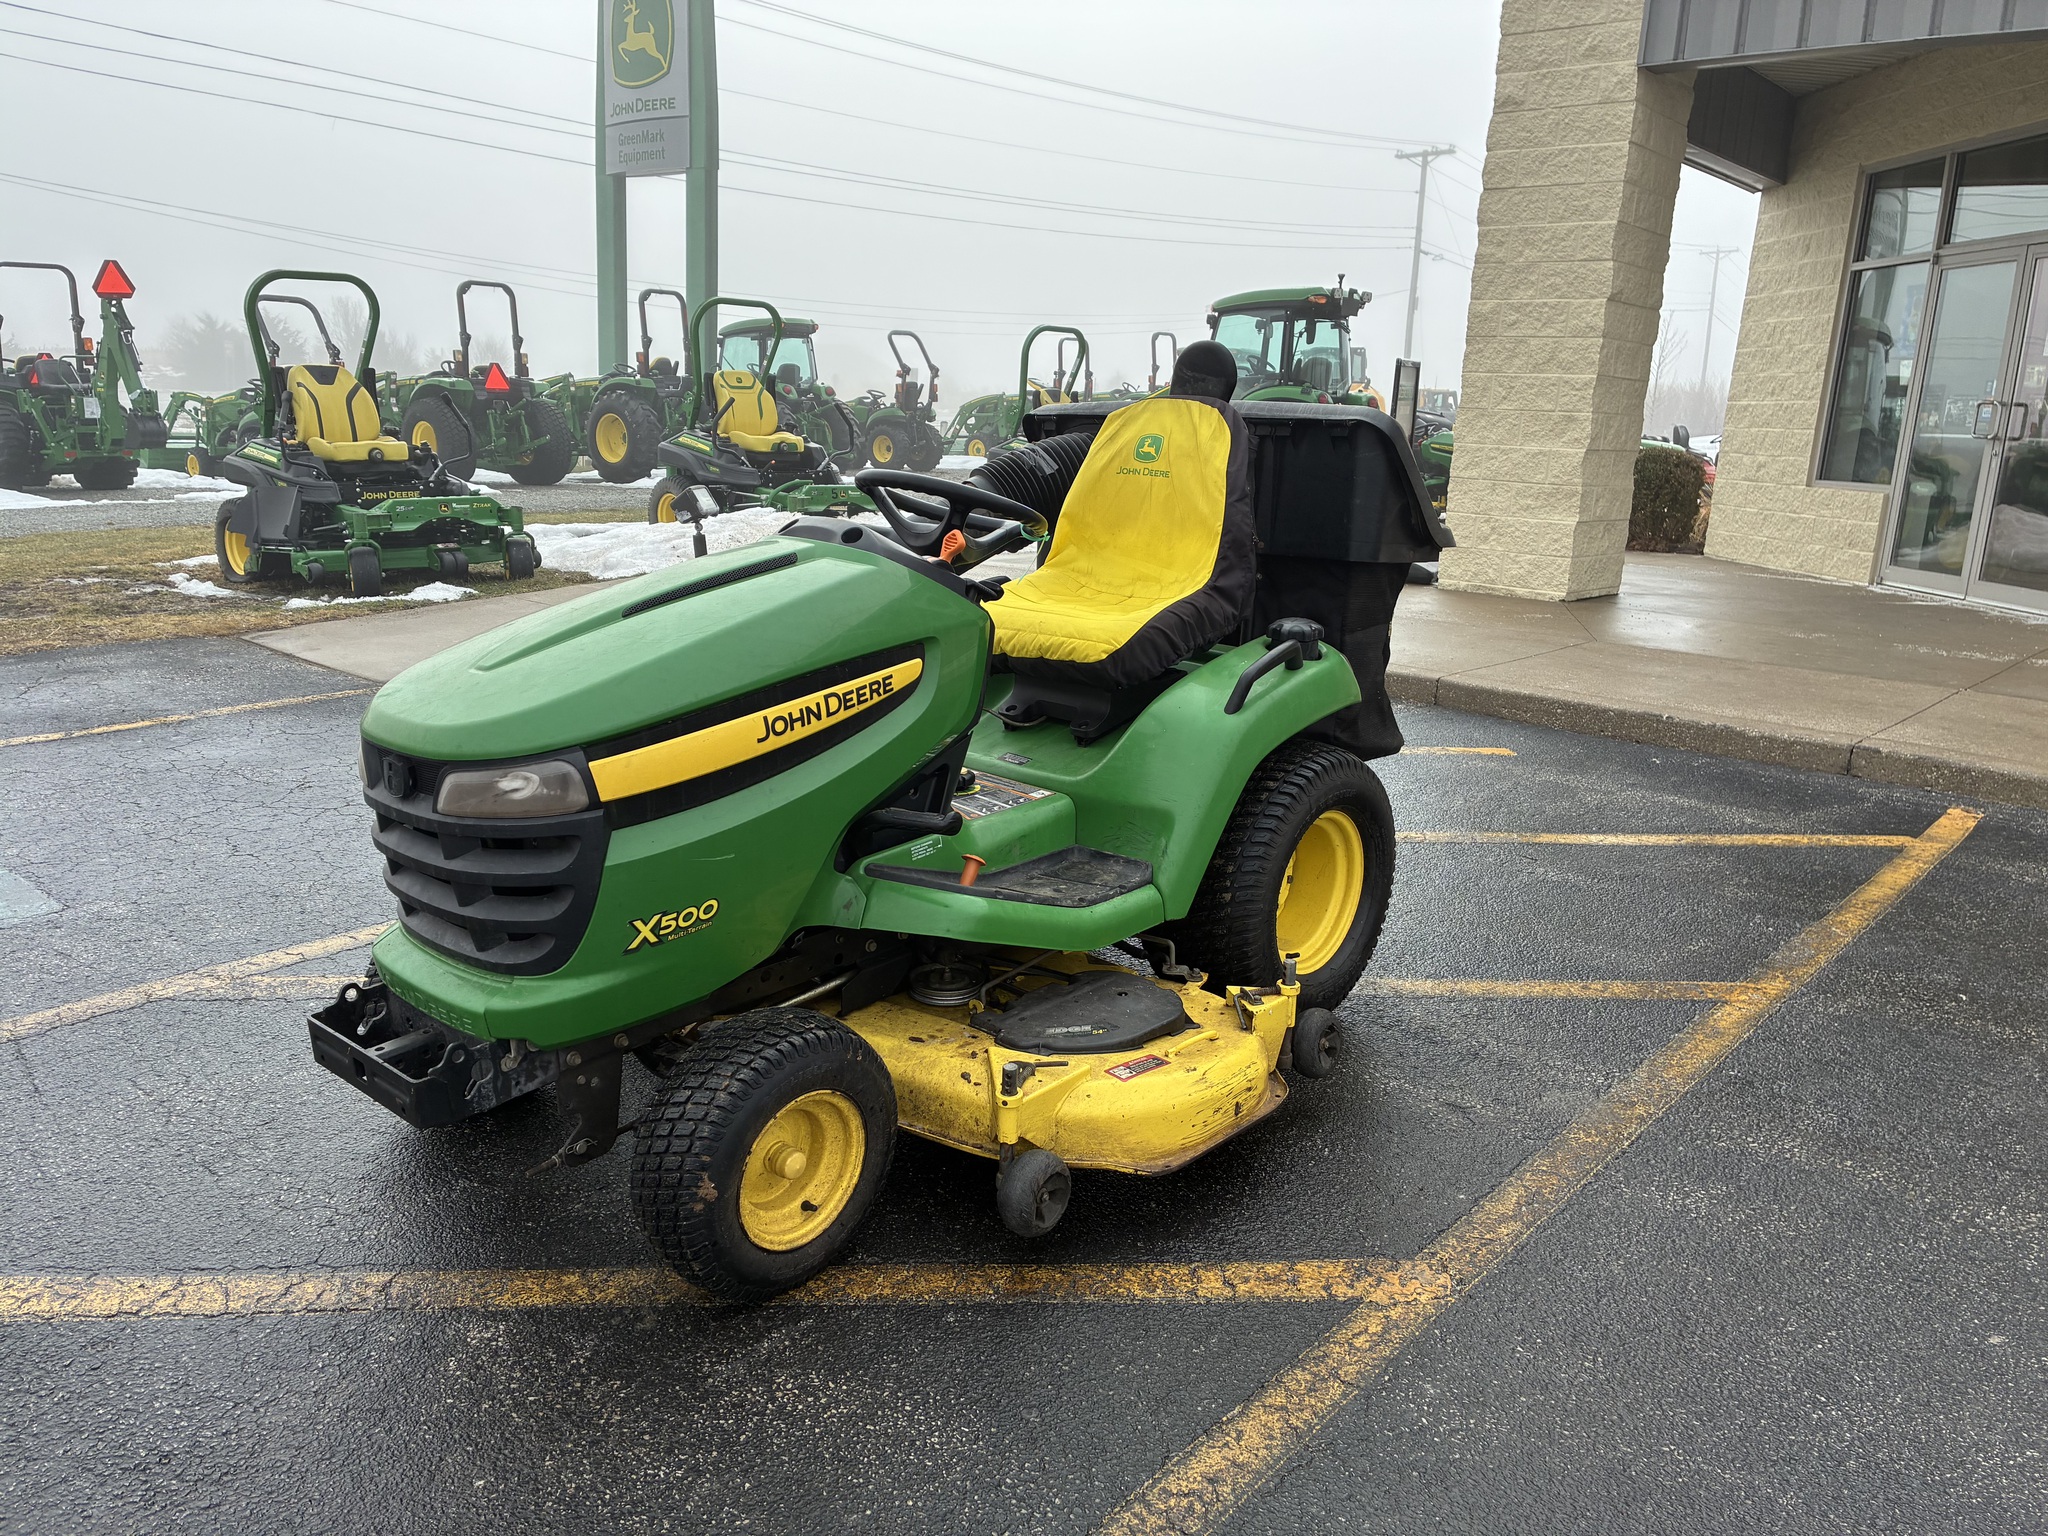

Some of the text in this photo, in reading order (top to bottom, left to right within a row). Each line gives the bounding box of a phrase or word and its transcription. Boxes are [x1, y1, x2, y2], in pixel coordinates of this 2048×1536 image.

[610, 97, 676, 117] JOHN DEERE
[618, 129, 665, 146] GreenMark
[618, 148, 666, 166] Equipment
[1116, 466, 1171, 478] JOHN DEERE
[361, 490, 420, 500] JOHN DEERE
[757, 674, 894, 743] JOHN DEERE
[623, 898, 720, 954] X500
